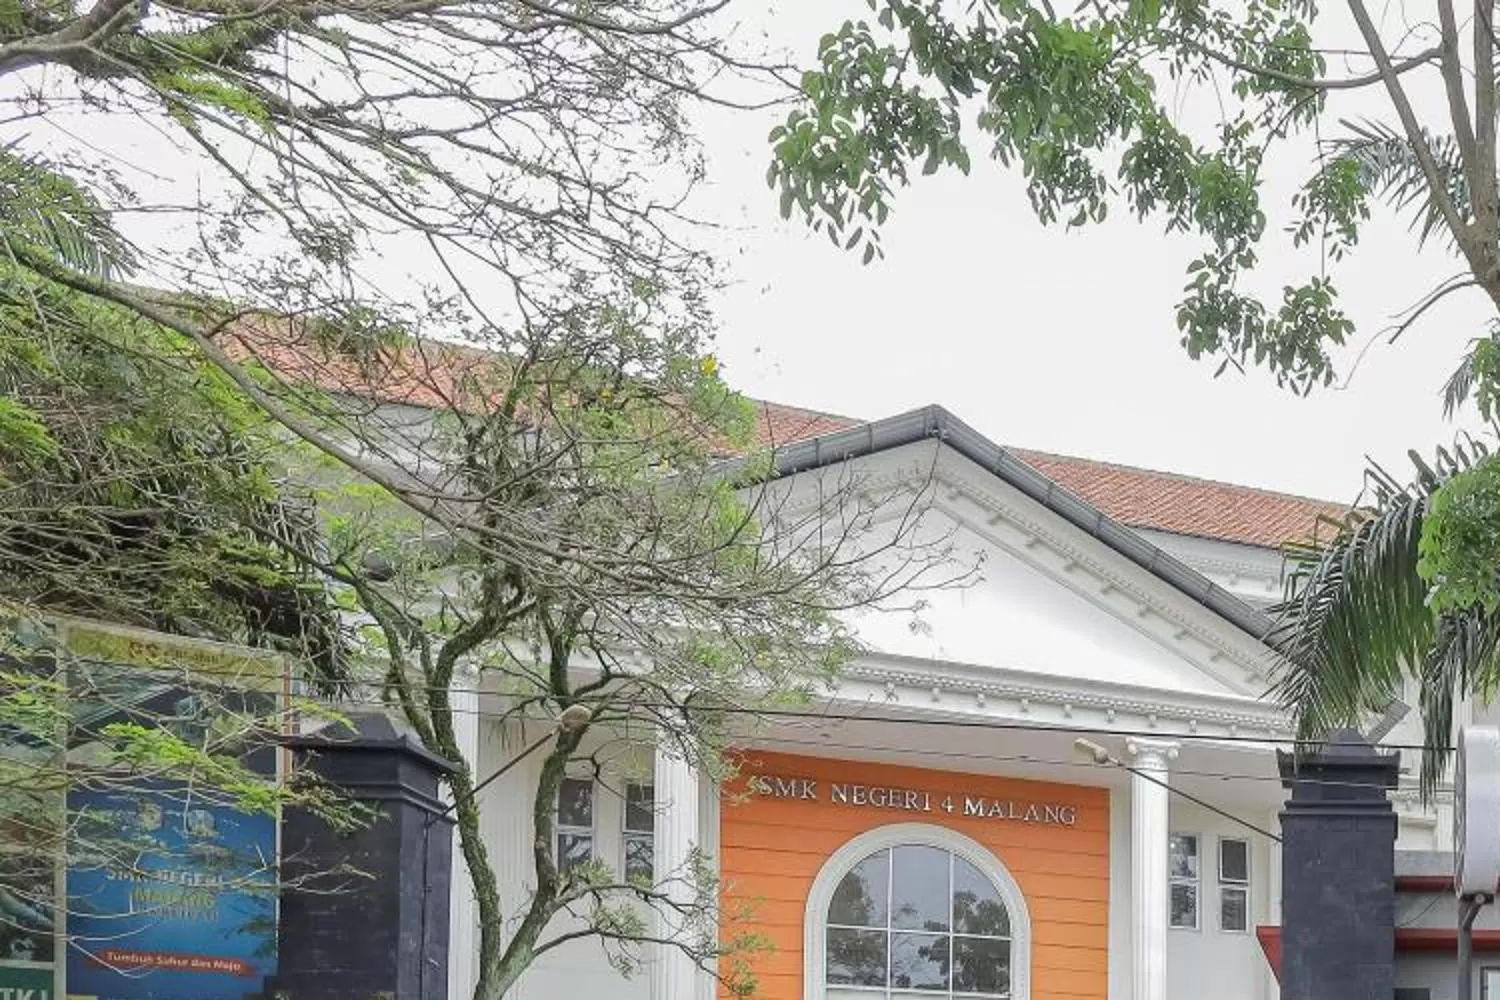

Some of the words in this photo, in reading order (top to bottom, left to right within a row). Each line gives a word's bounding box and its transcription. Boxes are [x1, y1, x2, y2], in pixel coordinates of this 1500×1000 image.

[758, 775, 817, 800] SMK
[831, 783, 932, 812] NEGERI
[941, 795, 954, 813] 4
[963, 796, 1076, 825] MALANG
